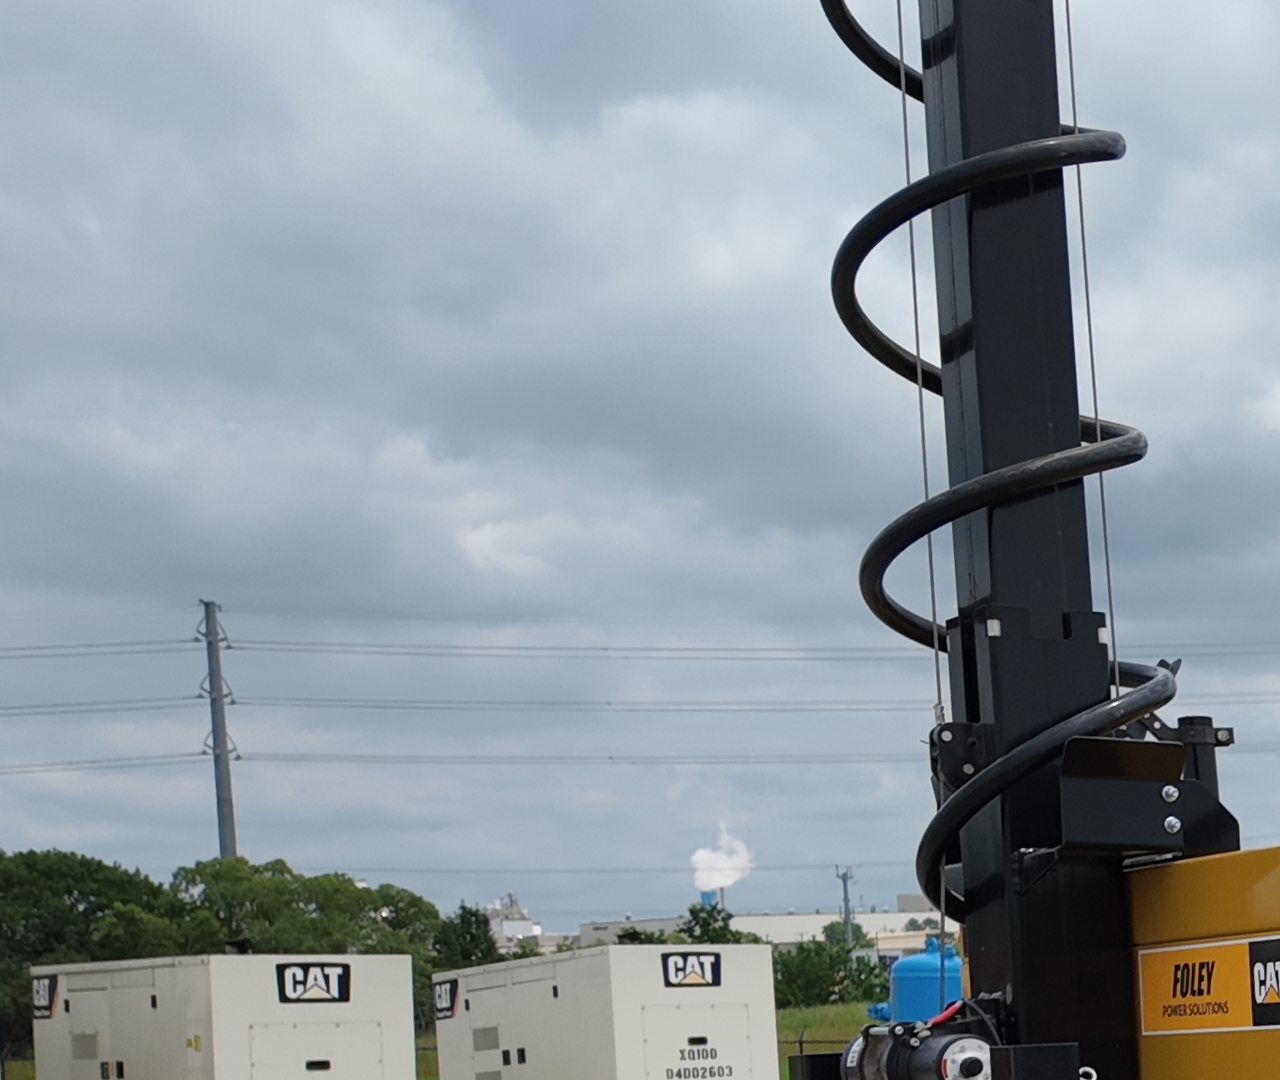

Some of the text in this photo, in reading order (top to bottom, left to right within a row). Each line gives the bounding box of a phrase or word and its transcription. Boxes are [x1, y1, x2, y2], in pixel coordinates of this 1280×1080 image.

[283, 966, 343, 1000] CAT
[667, 955, 716, 985] CAT
[1172, 960, 1216, 999] FOLEY
[435, 982, 452, 1009] CAT
[1162, 1001, 1230, 1018] POWER SOLUTIONS
[679, 1047, 718, 1062] XQ100
